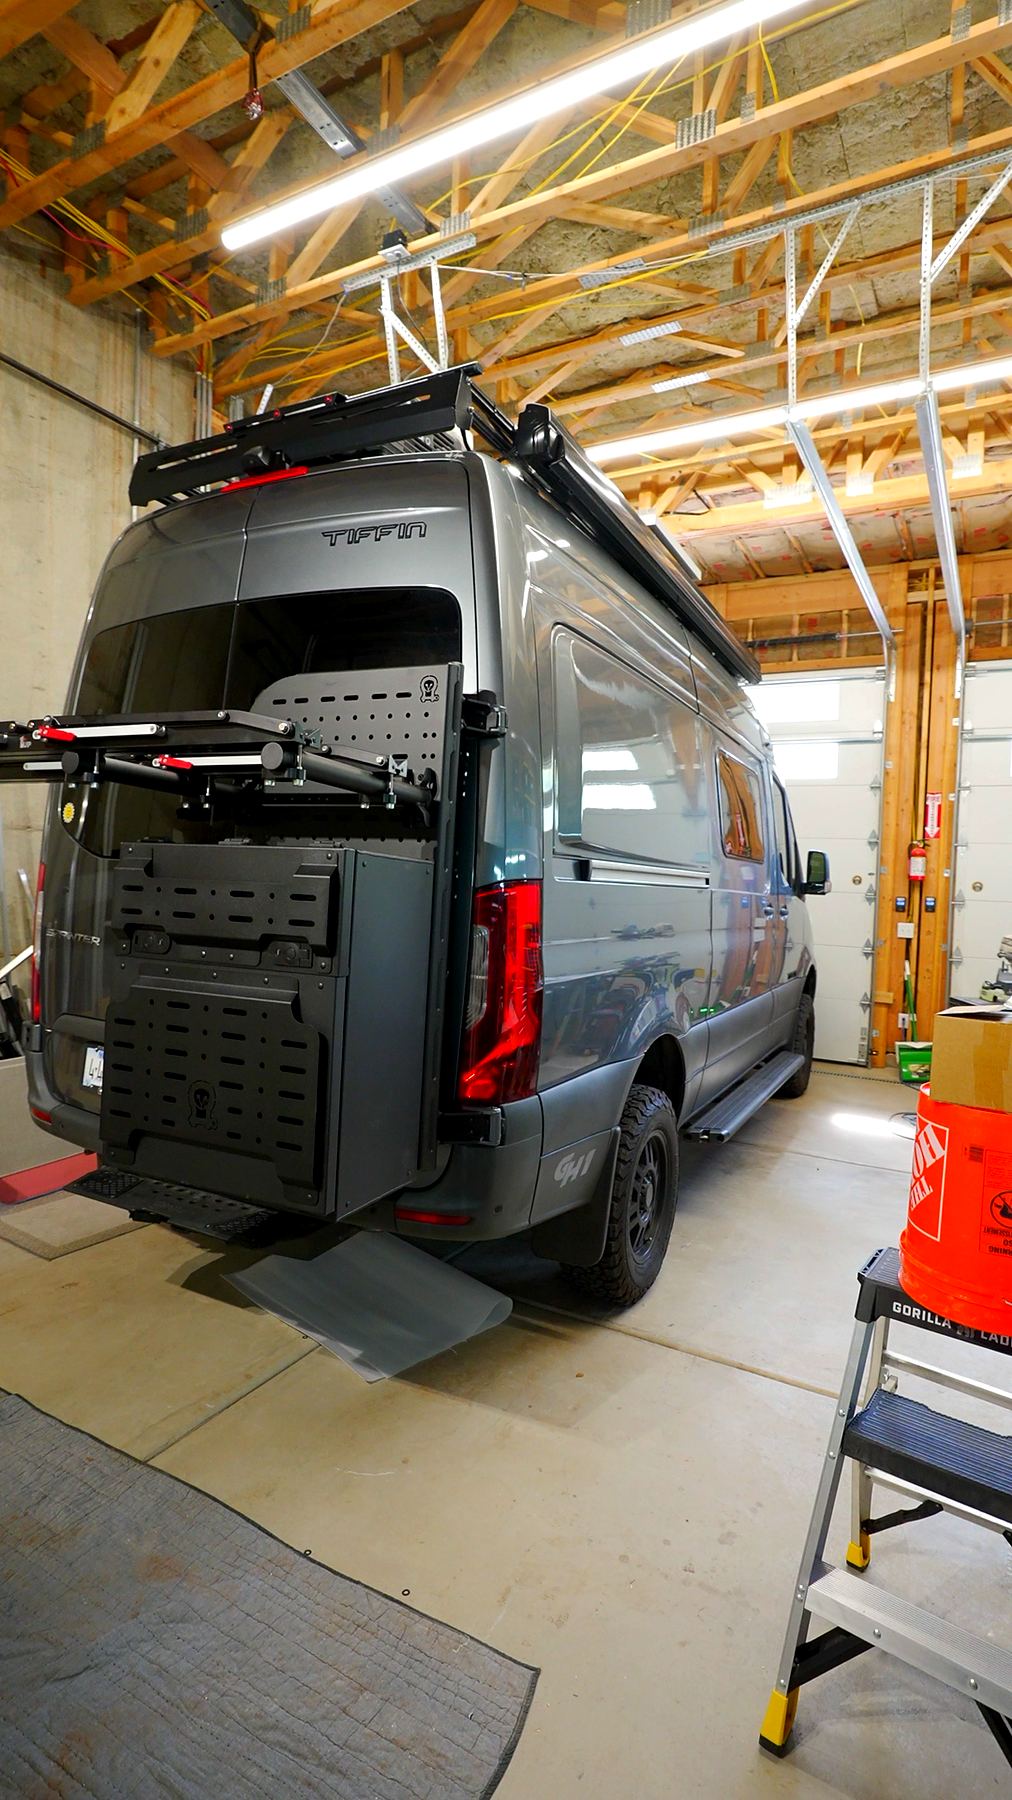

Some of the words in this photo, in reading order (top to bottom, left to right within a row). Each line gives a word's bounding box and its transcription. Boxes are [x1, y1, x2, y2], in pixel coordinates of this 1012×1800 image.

[321, 521, 427, 546] TIFFIN
[912, 1123, 945, 1178] HO
[892, 1301, 952, 1329] GORILLA
[980, 1331, 1012, 1348] LAD
